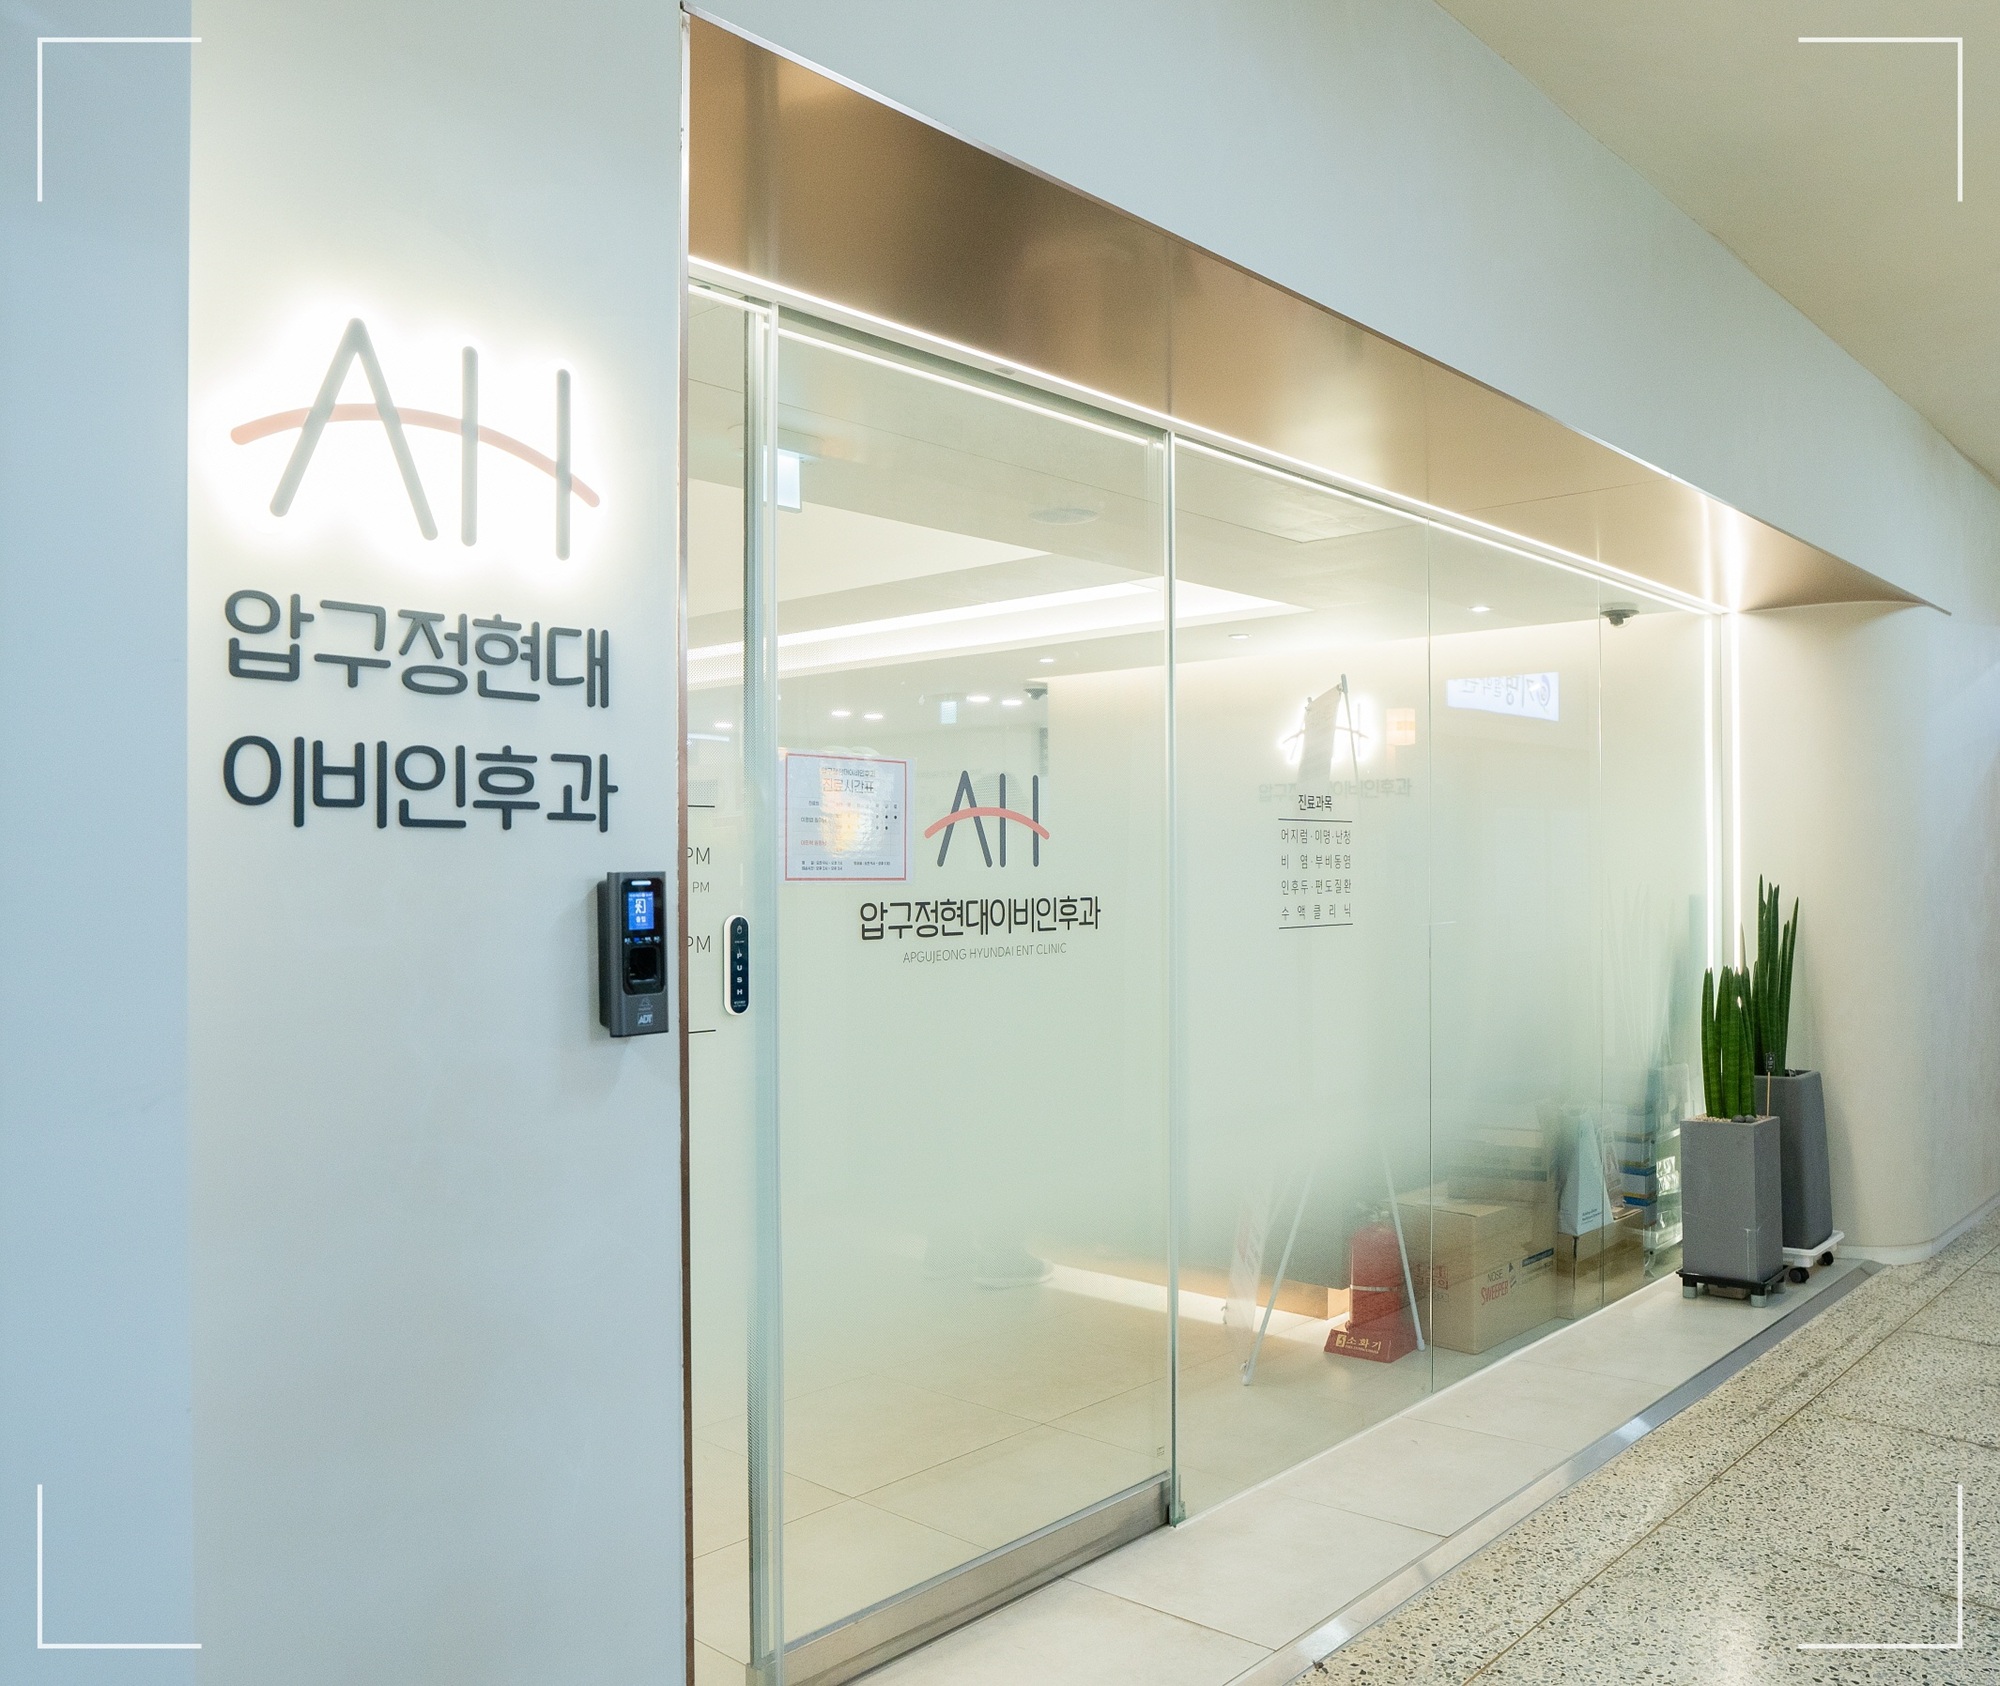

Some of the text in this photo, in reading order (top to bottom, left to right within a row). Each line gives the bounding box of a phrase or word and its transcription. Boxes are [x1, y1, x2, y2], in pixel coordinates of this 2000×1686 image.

[231, 318, 600, 561] AH
[224, 589, 609, 708] 압구정현대
[223, 735, 619, 833] 이비인후과
[924, 770, 1050, 868] AH
[1298, 794, 1333, 812] 진료과목
[692, 881, 710, 893] PM
[859, 895, 1101, 940] 압구정현대이비인후과
[902, 942, 1067, 964] APGUJEONG HYUNDAI ENT CLINIC
[638, 1014, 653, 1024] ADT
[1346, 1336, 1382, 1351] 소화기
